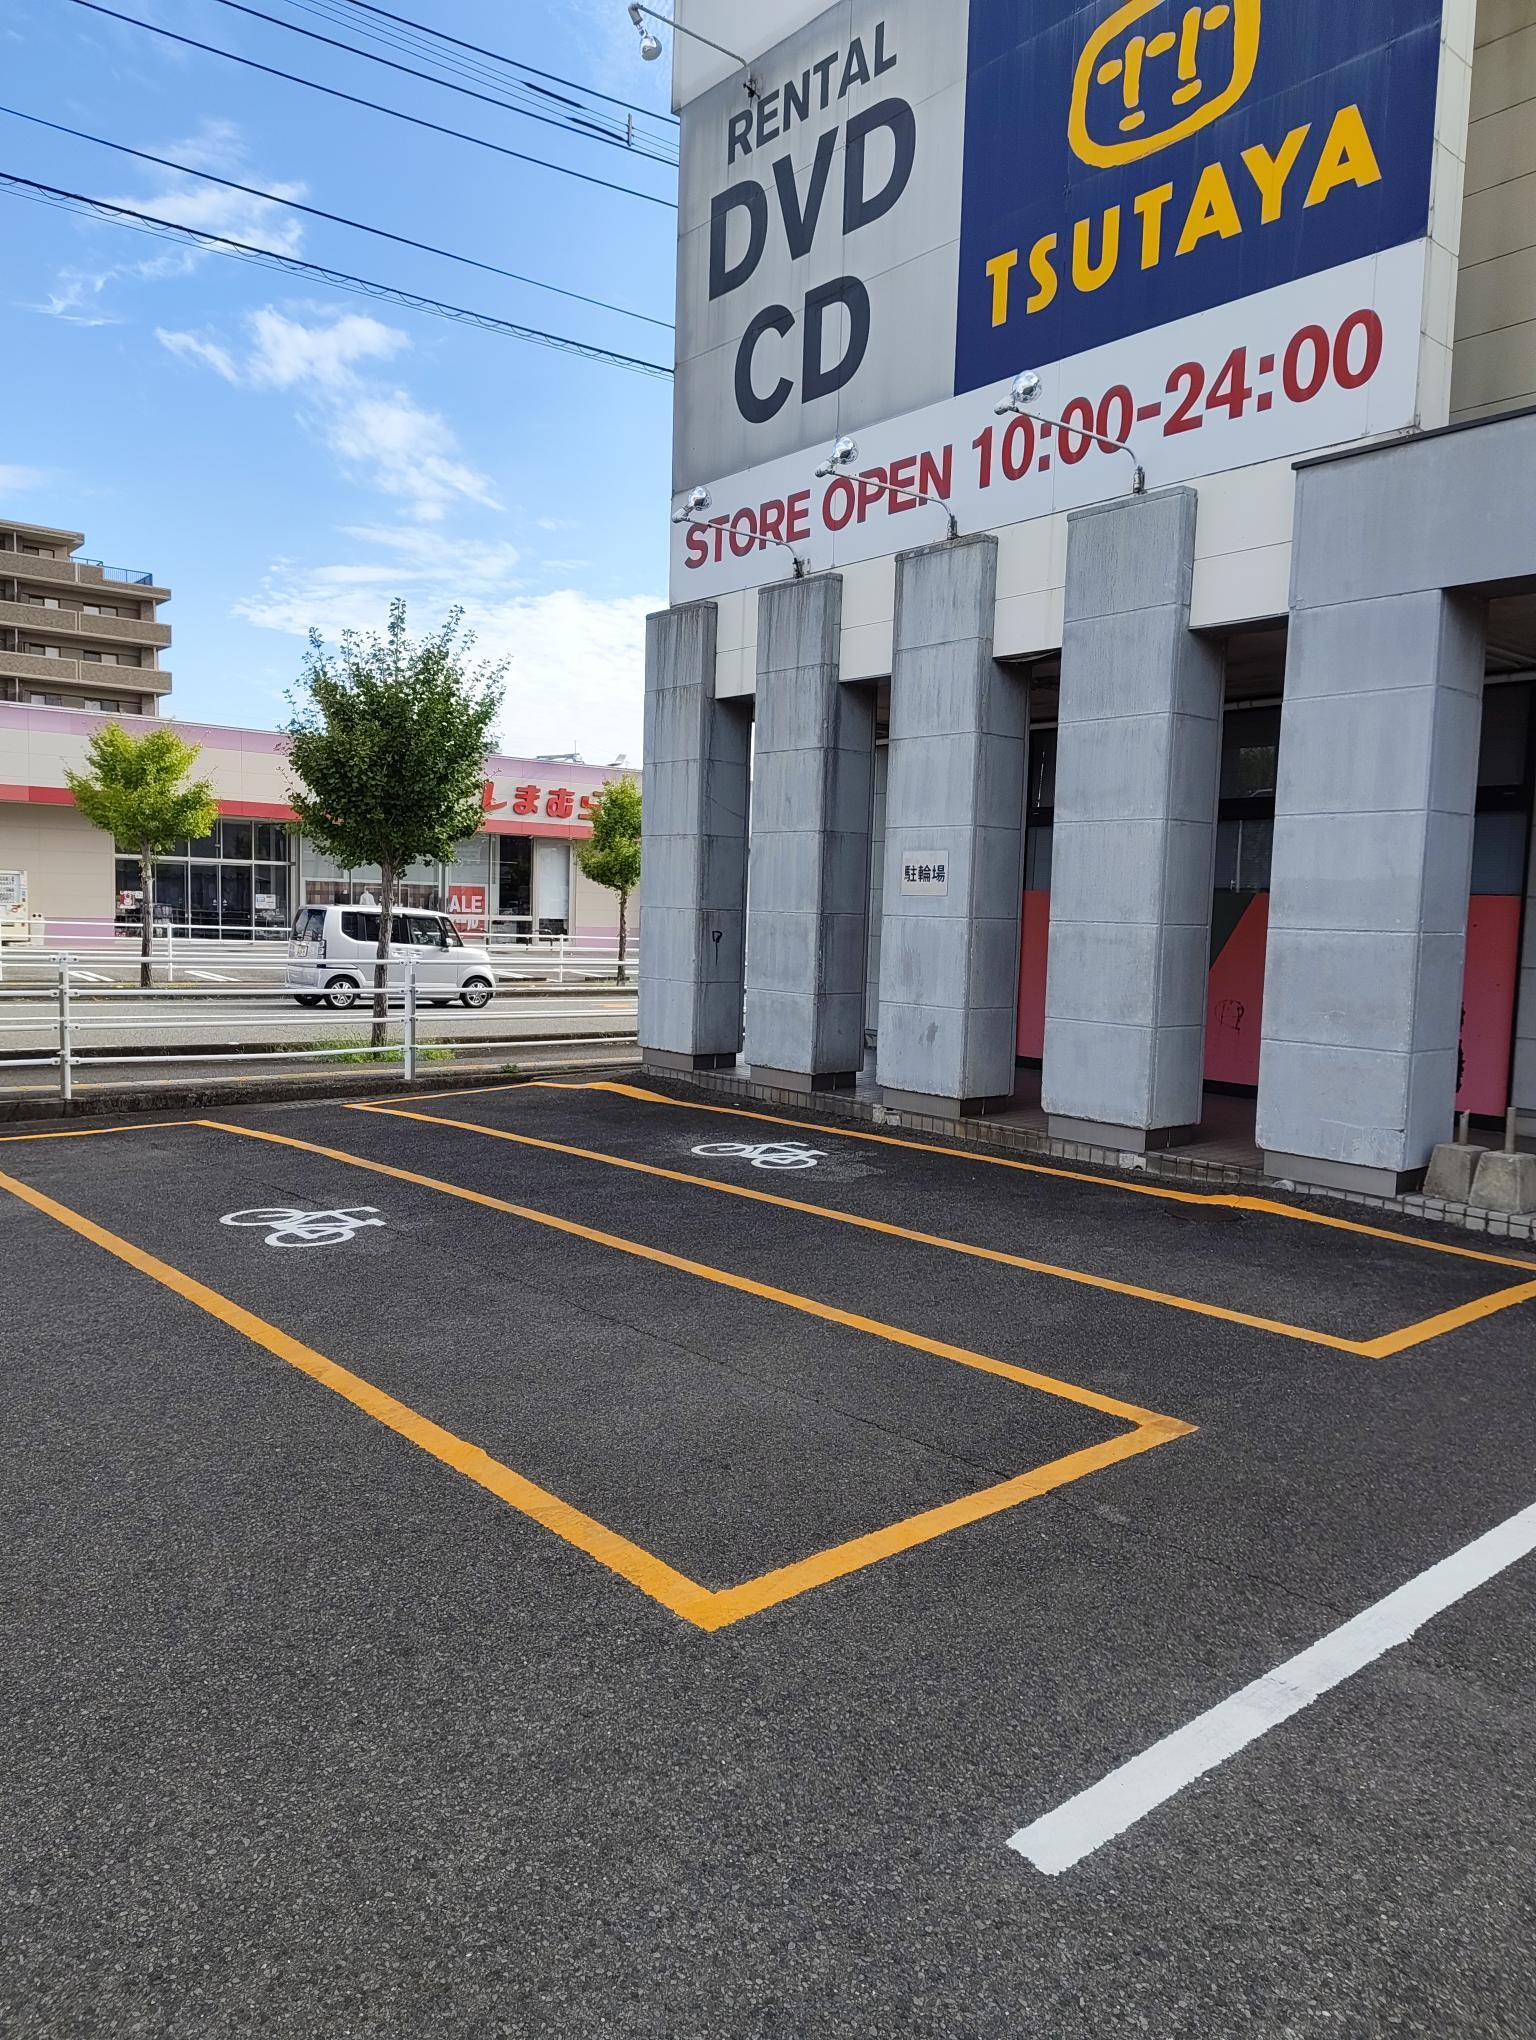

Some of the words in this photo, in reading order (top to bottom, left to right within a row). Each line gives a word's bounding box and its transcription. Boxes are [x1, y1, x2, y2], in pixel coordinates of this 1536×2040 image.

[727, 20, 898, 166] RENTAL
[708, 97, 917, 302] DVD
[985, 103, 1383, 328] TSUTAYA
[734, 275, 871, 424] CD
[684, 488, 812, 569] STORE
[821, 443, 954, 532] OPEN
[971, 308, 1384, 489] 10:00-24:00
[447, 894, 483, 913] ALE
[904, 864, 946, 883] 駐輪場
